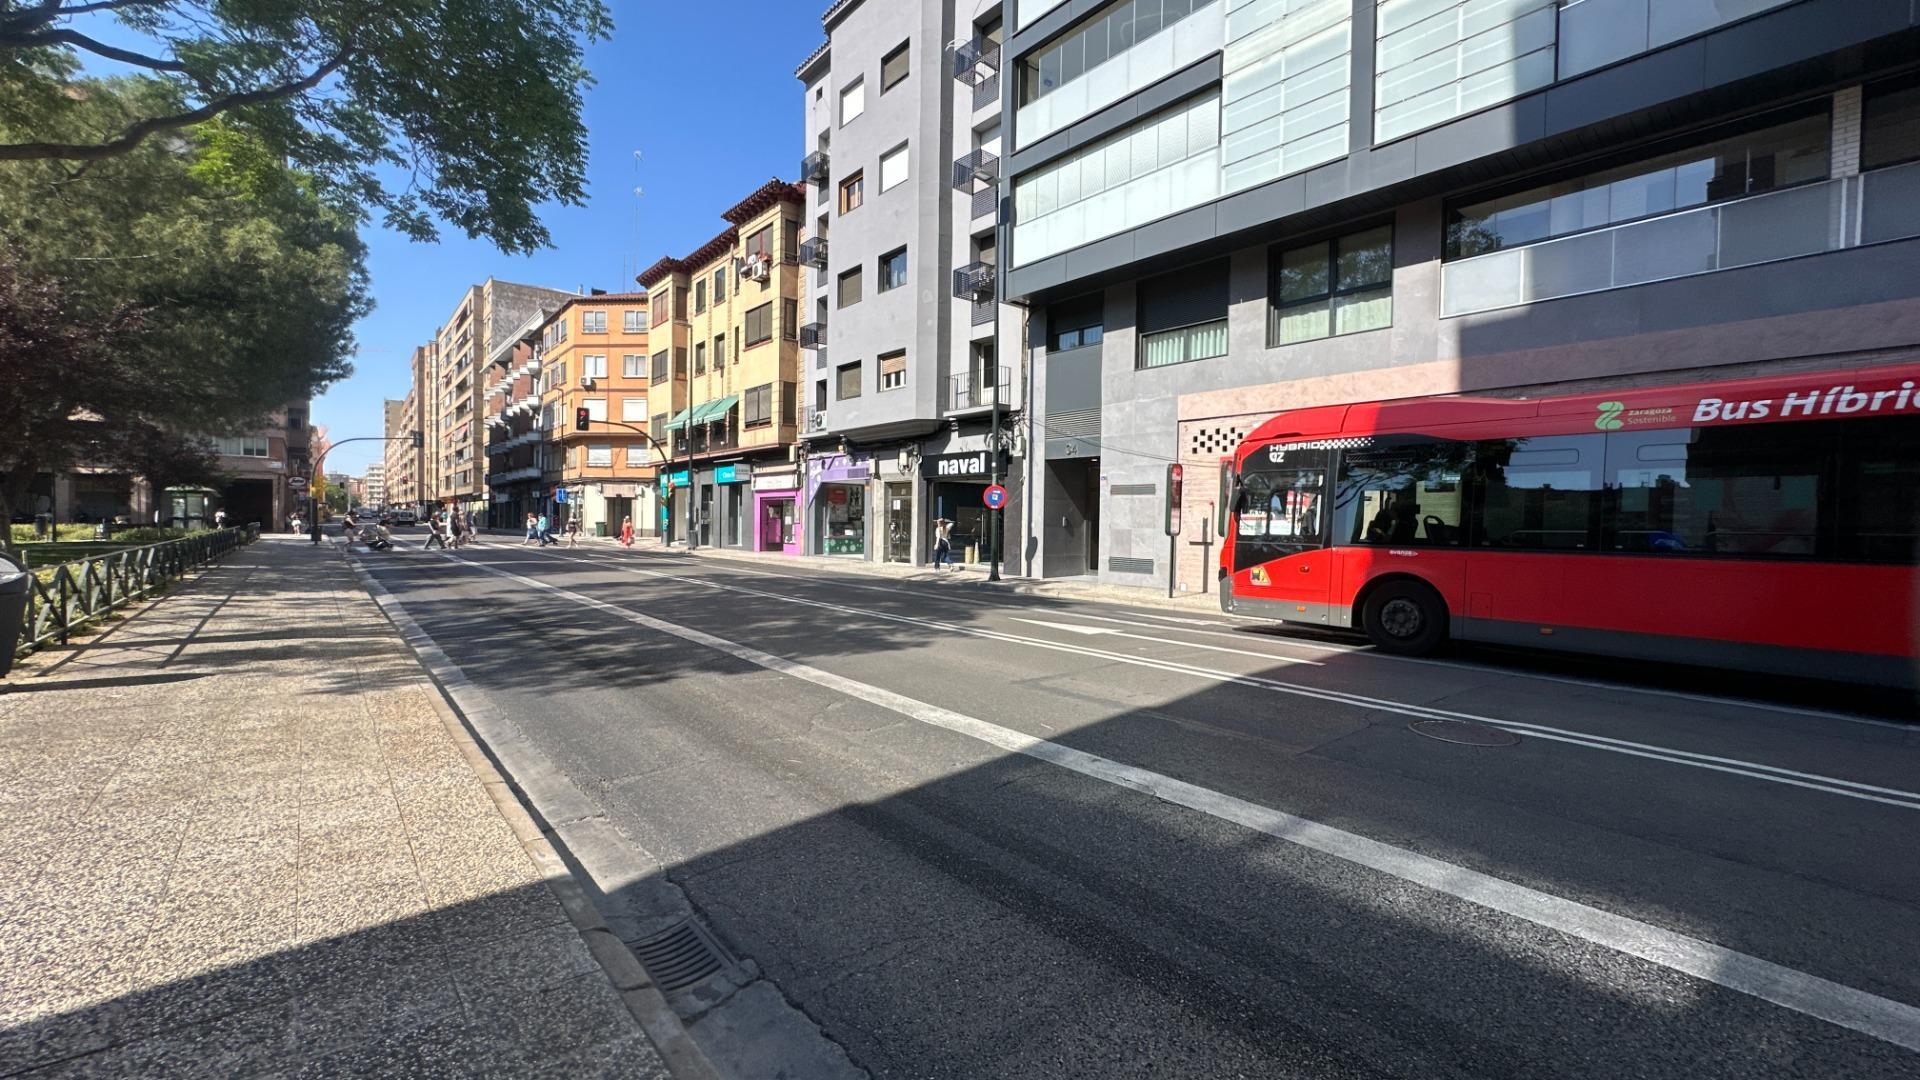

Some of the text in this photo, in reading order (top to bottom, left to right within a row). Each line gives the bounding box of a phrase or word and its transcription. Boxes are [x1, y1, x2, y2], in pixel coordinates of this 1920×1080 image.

[1692, 381, 1920, 422] Bus Híbri
[1269, 441, 1320, 452] HYBRID
[938, 452, 986, 475] naval
